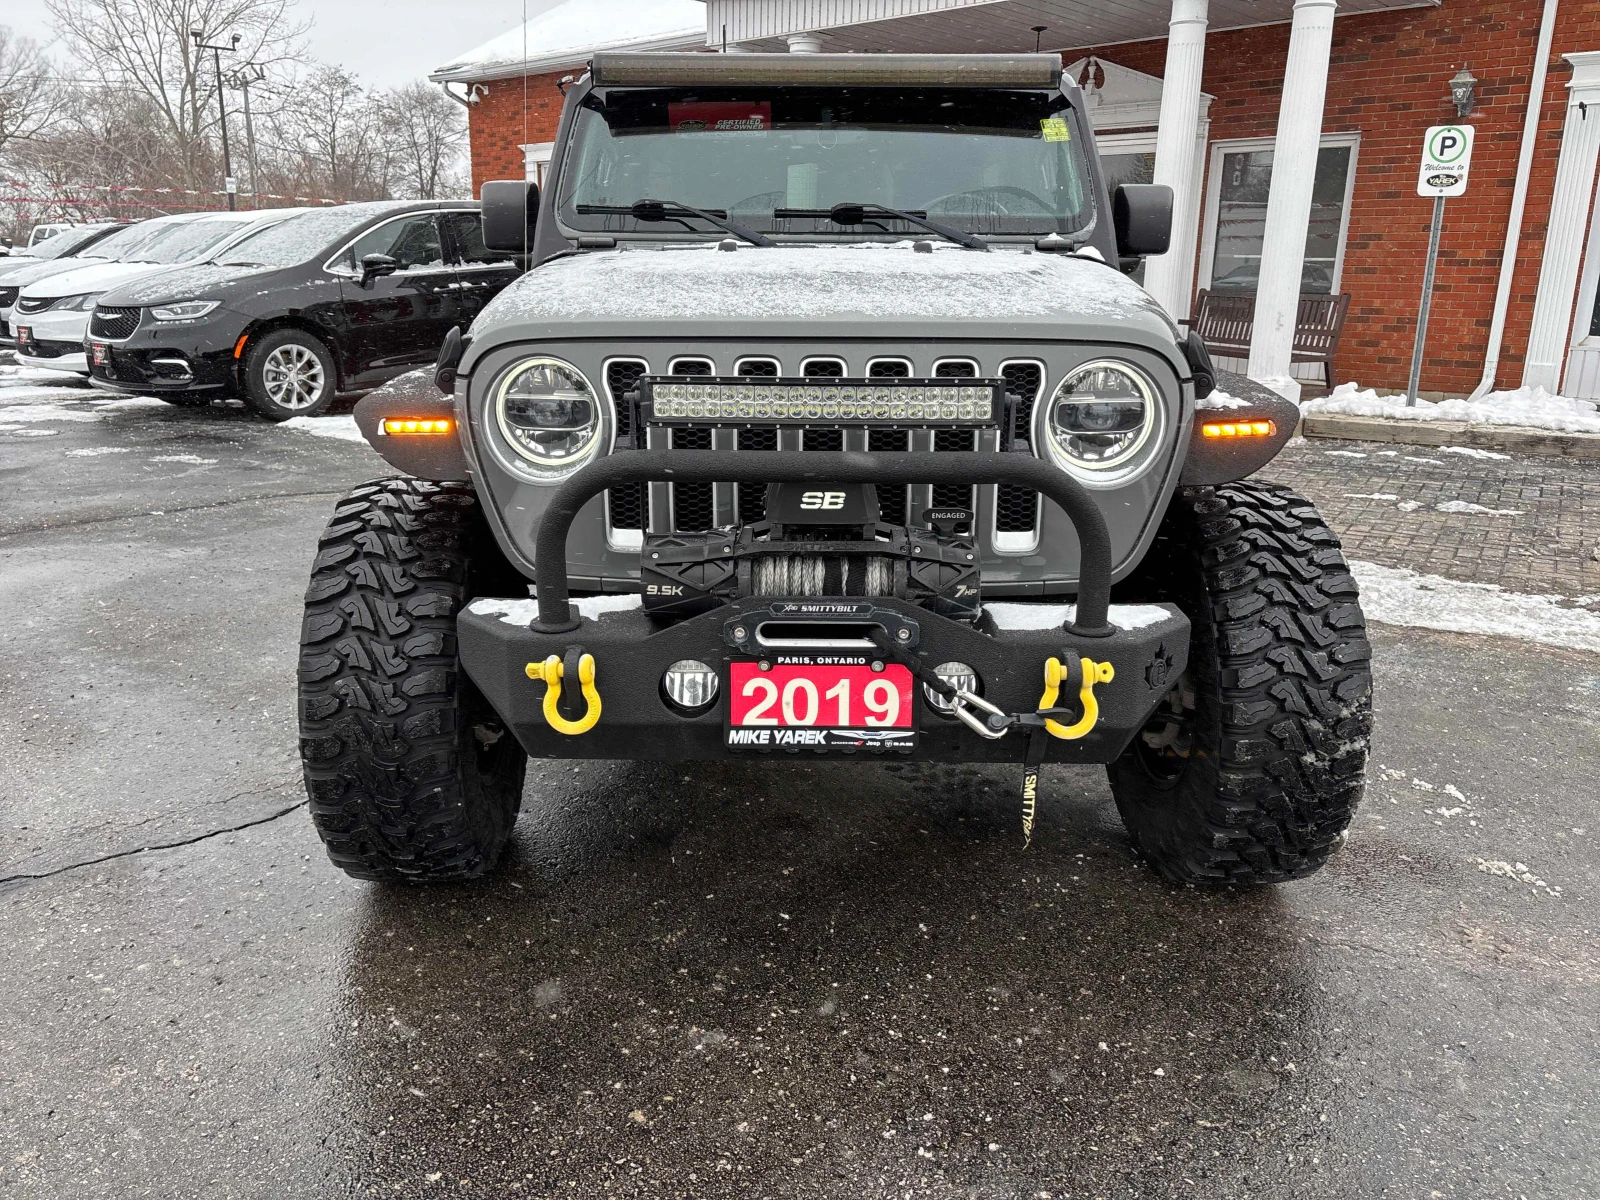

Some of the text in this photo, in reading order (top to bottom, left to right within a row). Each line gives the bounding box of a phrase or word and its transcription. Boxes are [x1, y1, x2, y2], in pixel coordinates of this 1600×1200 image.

[1439, 136, 1457, 156] P
[1424, 163, 1455, 171] Welcome
[800, 491, 846, 510] SB
[646, 584, 684, 596] 9.5K
[800, 604, 858, 613] SMITTYBILT
[777, 657, 814, 665] PARIS,
[742, 677, 900, 726] 2019
[728, 730, 828, 745] MIKE YAREK
